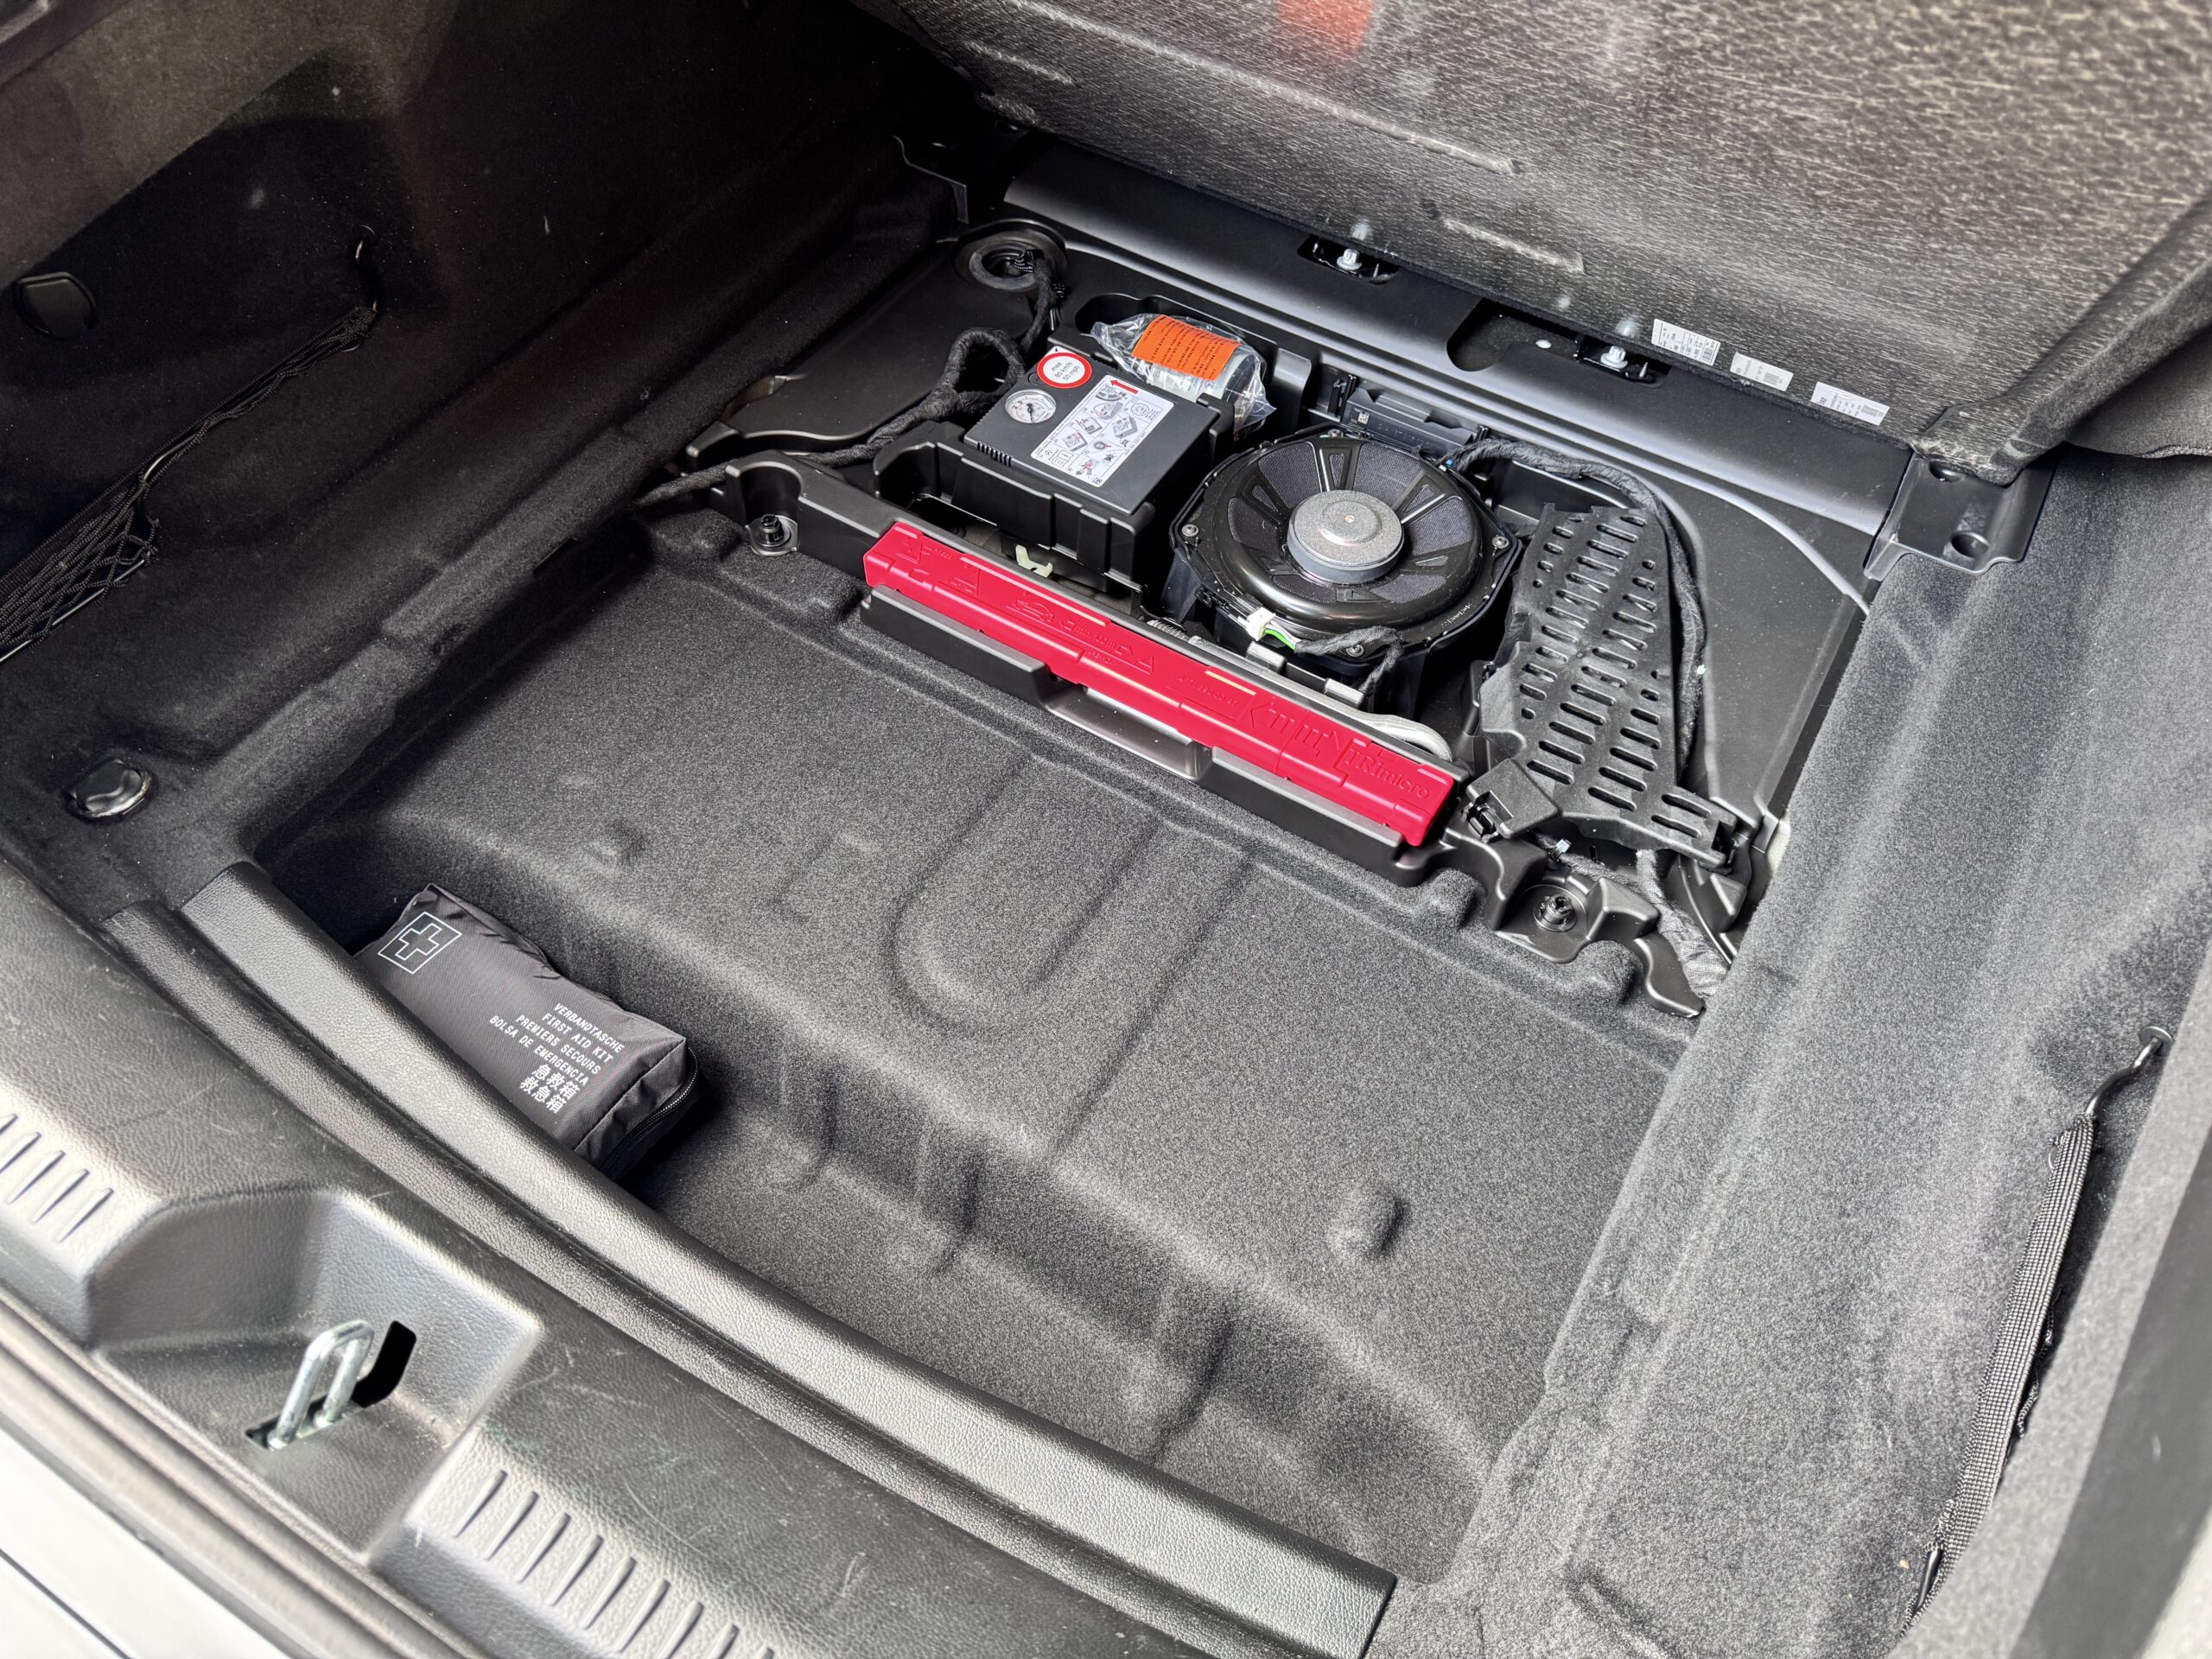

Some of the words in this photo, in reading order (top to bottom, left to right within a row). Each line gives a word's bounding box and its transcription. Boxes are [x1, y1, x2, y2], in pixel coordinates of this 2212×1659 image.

[1344, 747, 1430, 799] TRImicro
[489, 1015, 518, 1038] BOLSA
[518, 1034, 534, 1048] DE
[534, 1045, 589, 1086] EMERGENCIA
[515, 1014, 560, 1046] PREMIERS
[560, 1044, 601, 1075] SECOURS
[542, 1013, 572, 1034] FIRST
[571, 1033, 592, 1048] AID
[592, 1046, 613, 1063] KIT
[554, 1003, 625, 1053] VERBANDTASCHE
[519, 1077, 568, 1114] 救急箱
[531, 1064, 581, 1101] 急救箱
